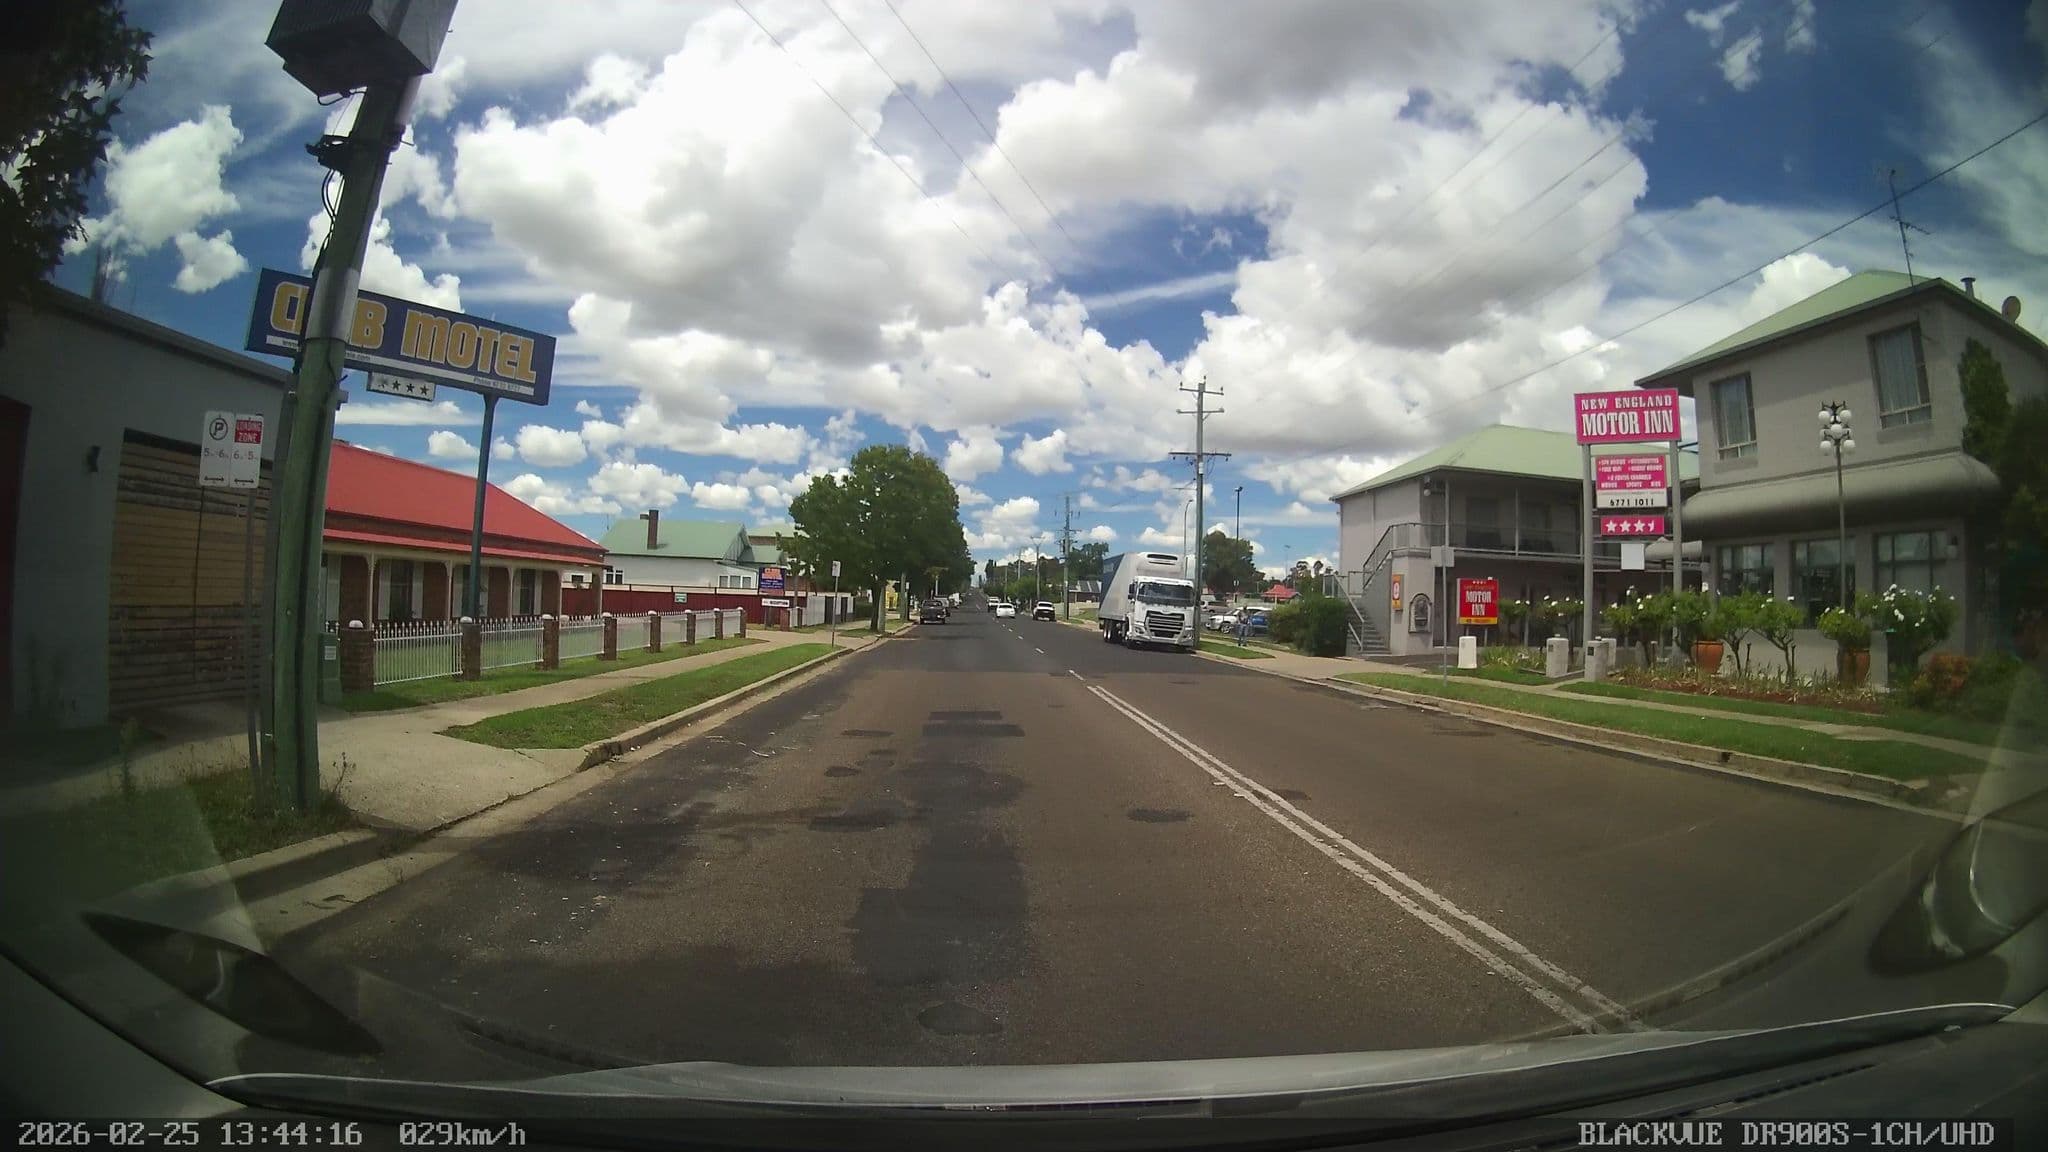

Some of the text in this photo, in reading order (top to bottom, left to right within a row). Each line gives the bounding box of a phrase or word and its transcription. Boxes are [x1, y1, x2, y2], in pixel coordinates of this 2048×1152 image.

[401, 309, 536, 383] MOTEL
[1581, 395, 1673, 411] NEW ENGLAND
[1583, 410, 1673, 436] MOTOR INN
[238, 432, 257, 442] ZONE
[1610, 498, 1654, 506] 6771 1011
[1466, 591, 1491, 603] MOTOR
[1472, 604, 1485, 615] INN
